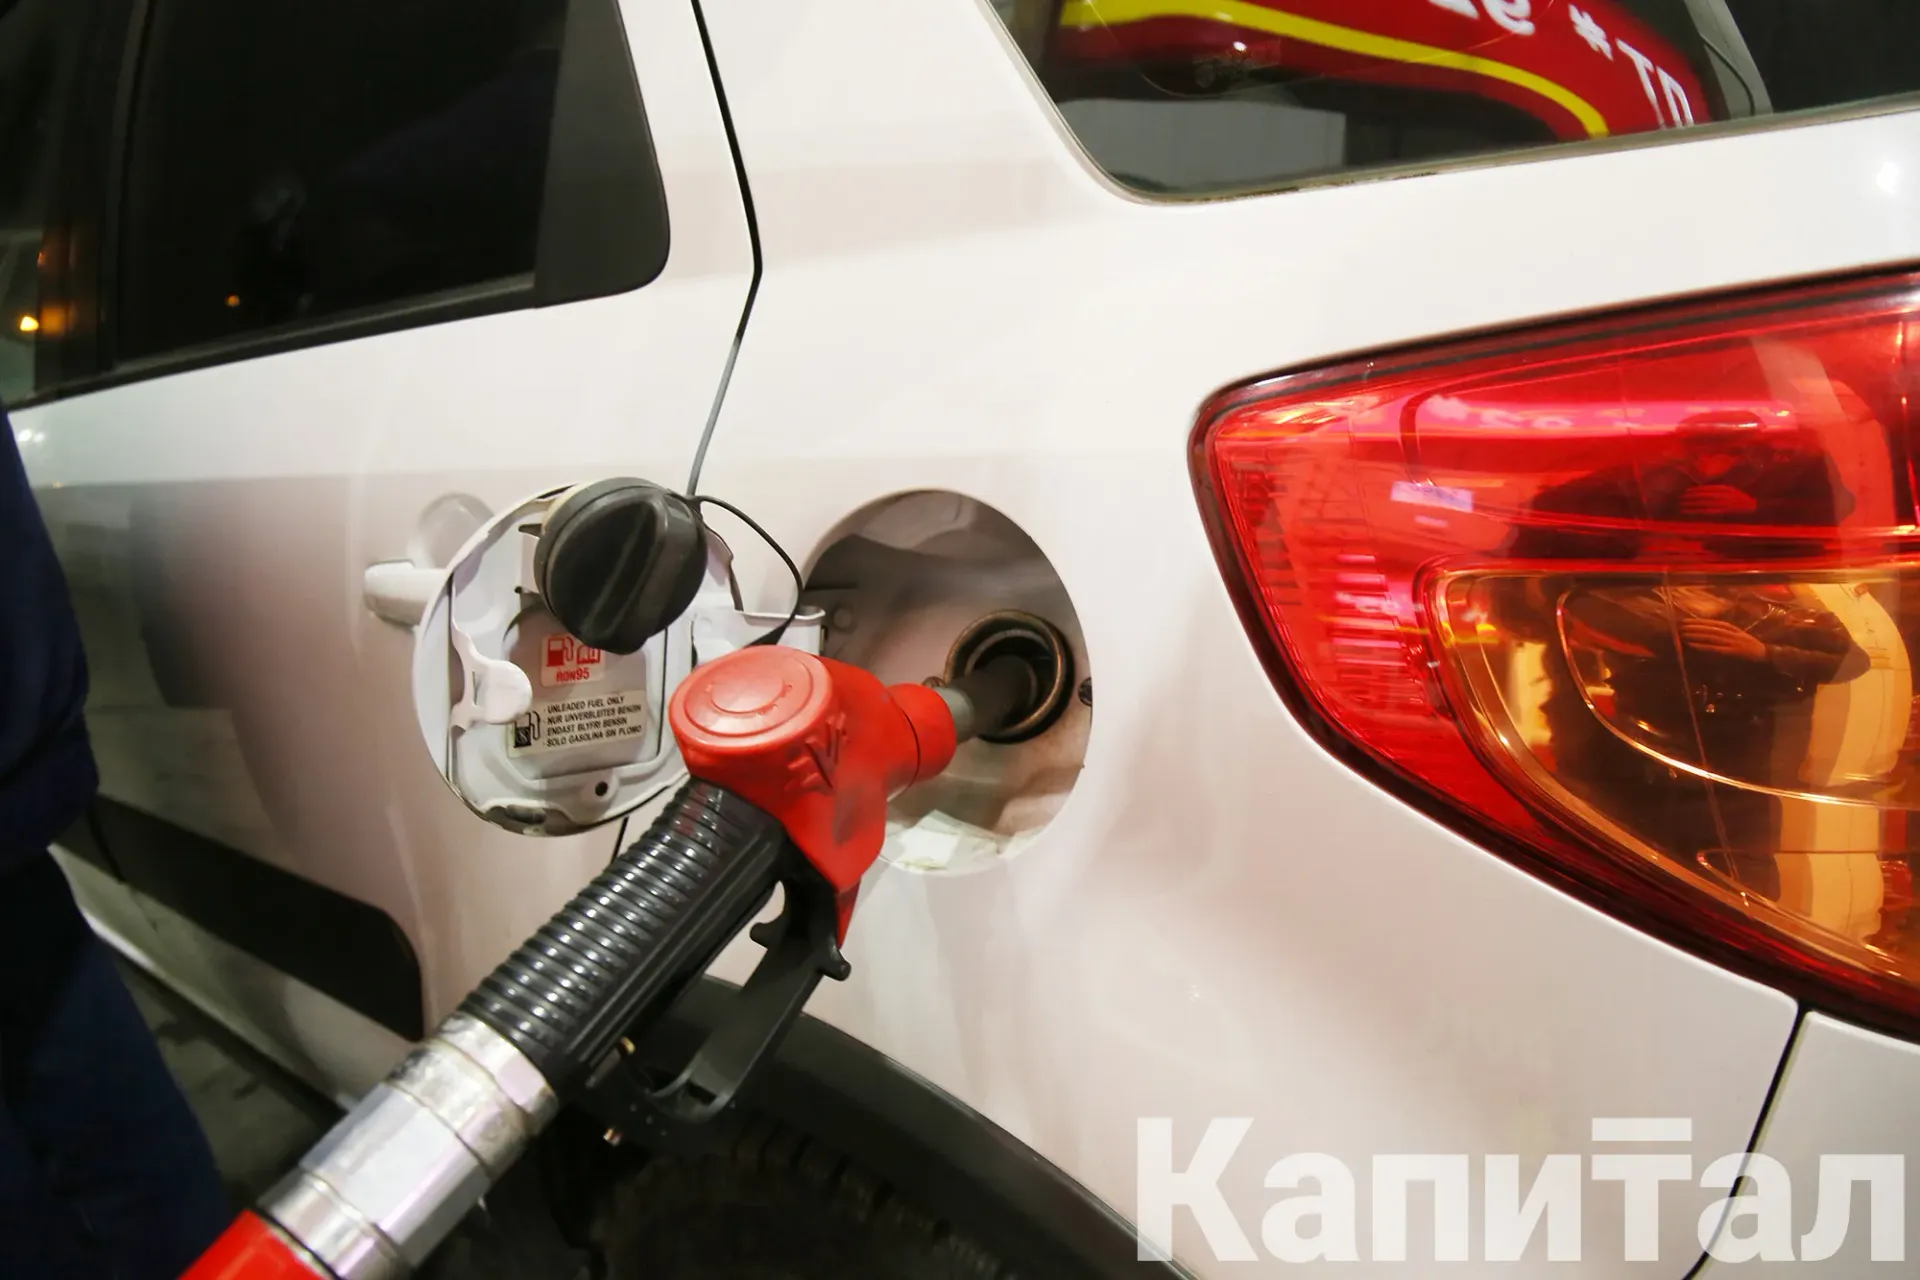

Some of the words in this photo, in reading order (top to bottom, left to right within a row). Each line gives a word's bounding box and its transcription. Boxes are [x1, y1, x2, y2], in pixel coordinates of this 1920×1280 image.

[556, 667, 590, 682] RON95
[547, 701, 586, 714] UNLEADED
[587, 698, 604, 708] FUEL
[607, 696, 625, 705] ONLY
[547, 715, 563, 726] NUR
[564, 707, 616, 721] UNVERBLEITES
[546, 737, 567, 748] SOLO
[568, 731, 604, 744] GASOLINA
[605, 729, 617, 737] SIN
[618, 725, 643, 736] PLOMO
[547, 724, 576, 737] ENDAST
[577, 720, 602, 732] BLYFRI
